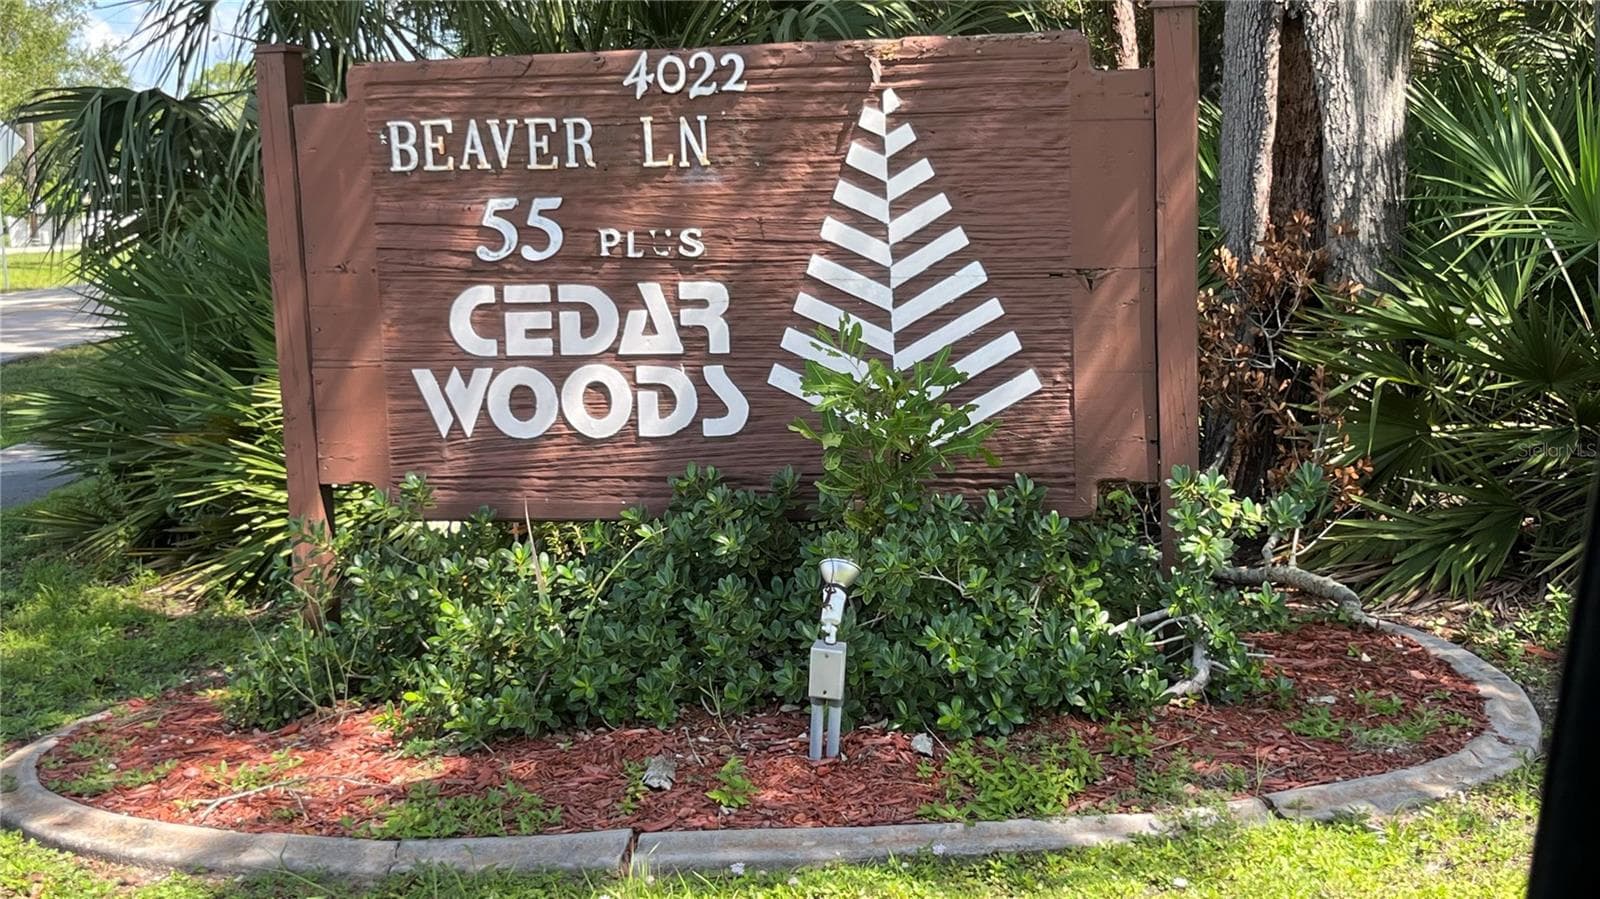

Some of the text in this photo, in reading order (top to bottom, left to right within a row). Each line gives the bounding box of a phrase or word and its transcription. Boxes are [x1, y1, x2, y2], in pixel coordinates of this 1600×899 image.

[623, 50, 748, 100] 4022
[386, 114, 712, 172] BEAVER LN
[475, 196, 564, 262] 55
[449, 281, 731, 357] CEDAR
[411, 363, 750, 439] WOODS
